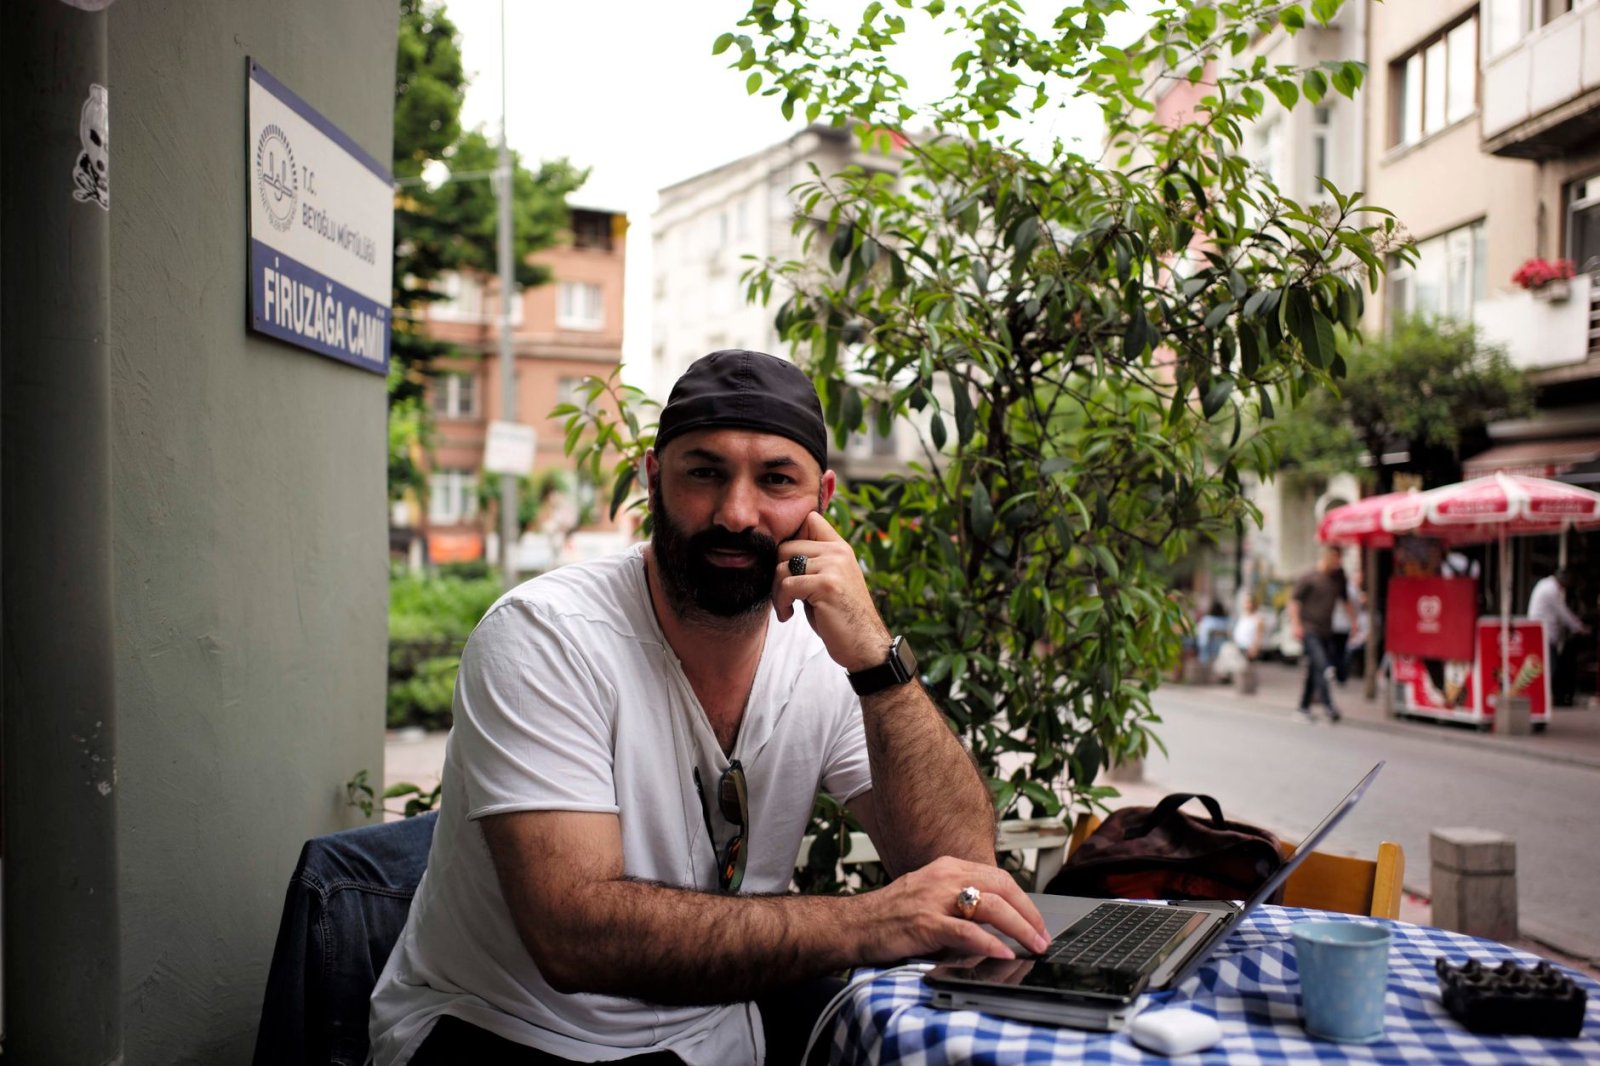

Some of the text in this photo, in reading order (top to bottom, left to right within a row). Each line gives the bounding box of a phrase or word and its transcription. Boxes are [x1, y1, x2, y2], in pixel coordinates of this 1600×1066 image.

[302, 166, 317, 196] T.C.
[302, 202, 336, 242] BEYOĞLU
[264, 256, 345, 350] FİRUZAĞA
